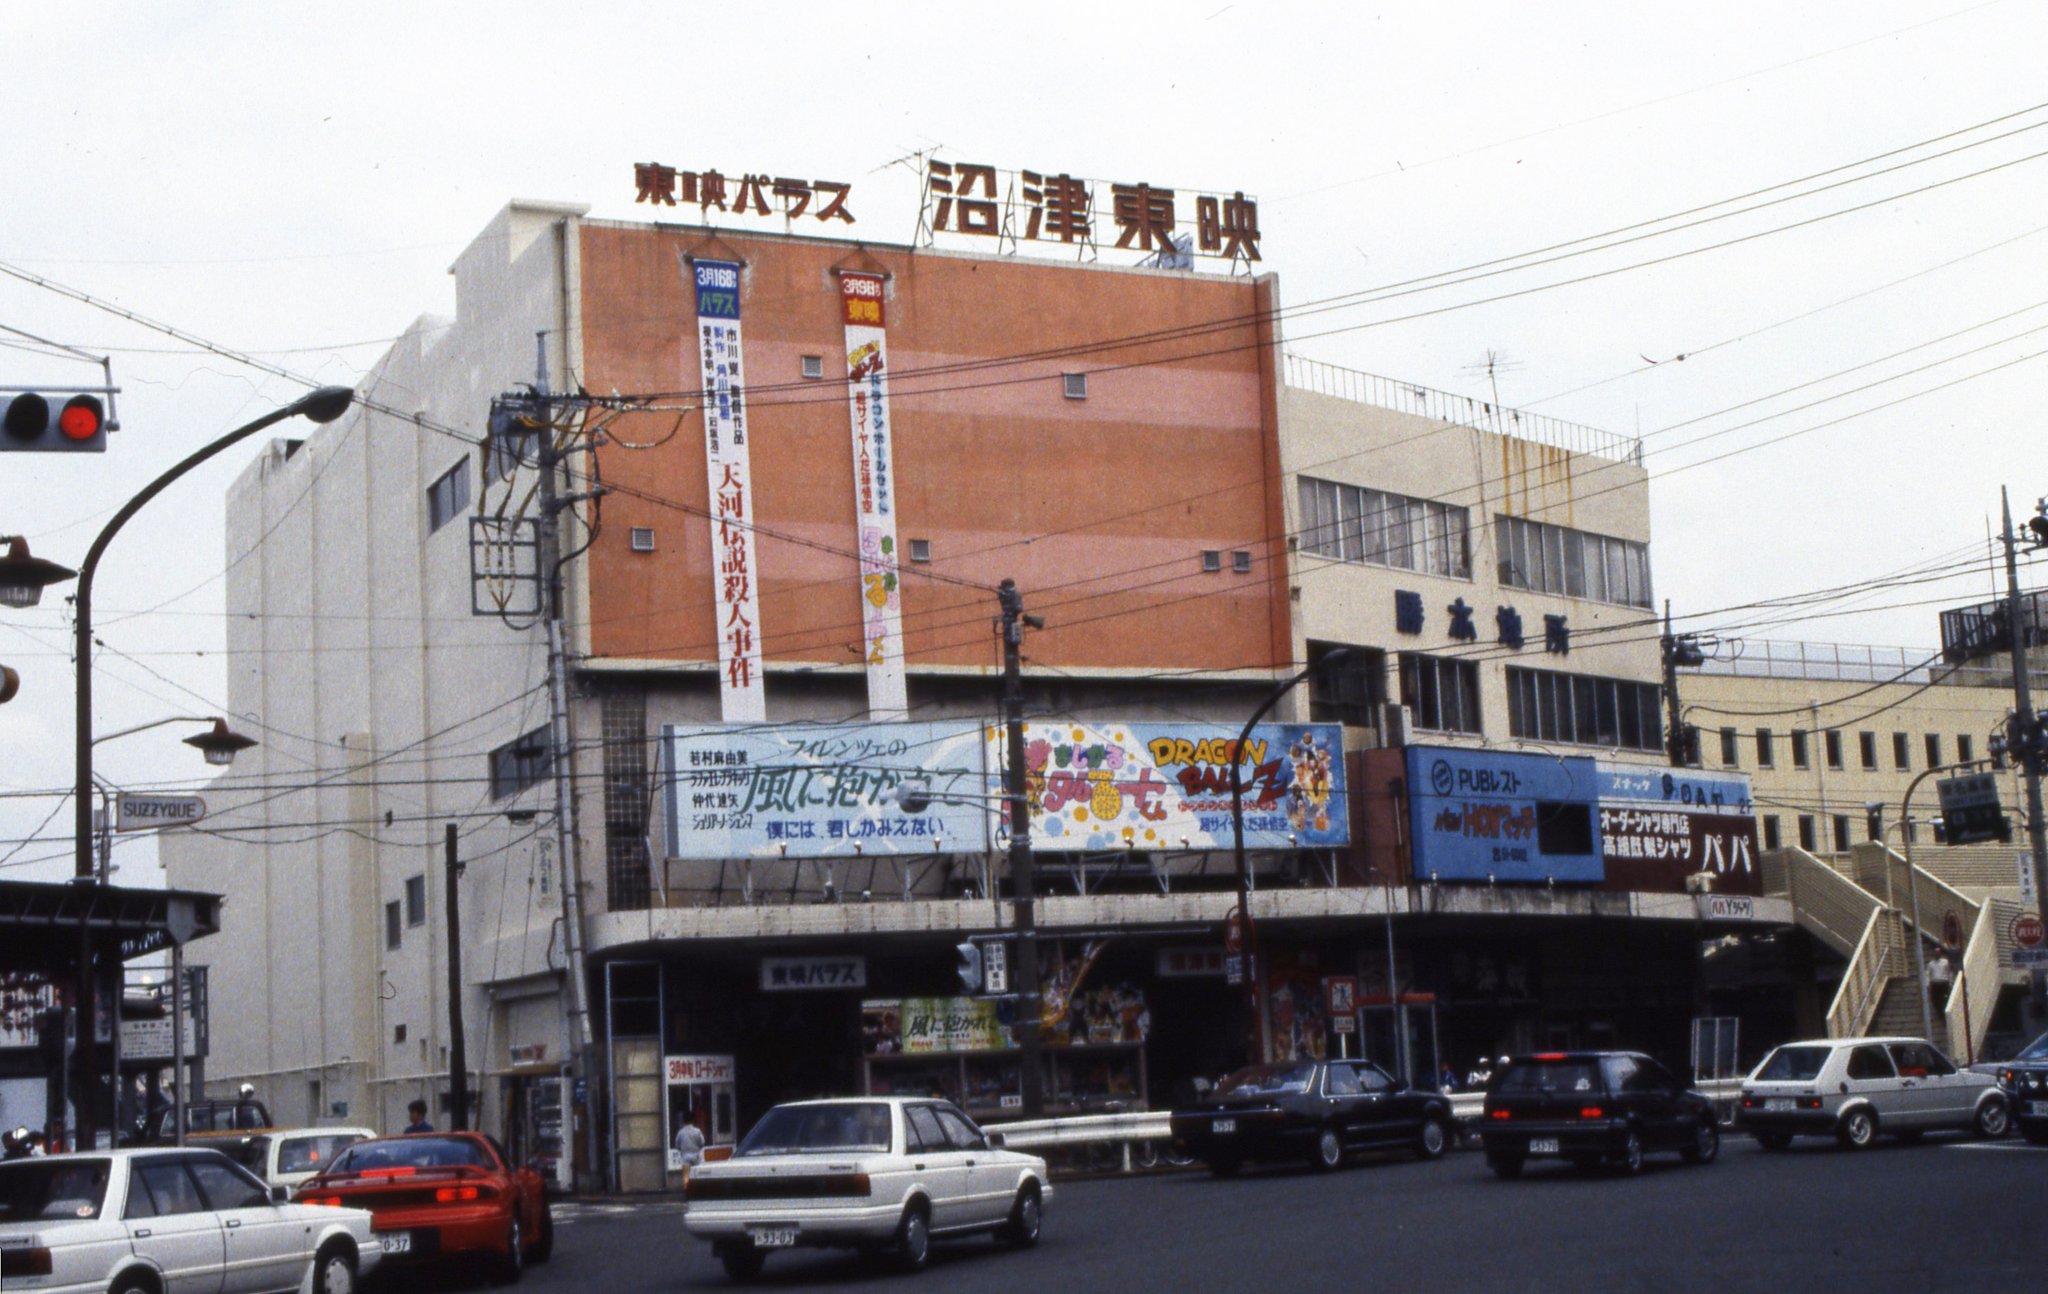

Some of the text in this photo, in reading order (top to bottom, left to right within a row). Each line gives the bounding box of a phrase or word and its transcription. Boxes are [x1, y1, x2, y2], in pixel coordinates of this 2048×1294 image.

[634, 162, 856, 224] 東映パラス
[929, 159, 1262, 261] 沼津東映
[718, 462, 752, 688] 天河伝説殺人事件
[1148, 737, 1268, 768] DRAGON
[1253, 757, 1287, 801] Z
[1612, 776, 1650, 792] スナック
[1738, 797, 1753, 814] 2F
[123, 802, 197, 819] SUZZYQUE
[1600, 809, 1690, 835] オーダーシャツ専門店
[1702, 833, 1752, 875] パパ
[772, 962, 858, 985] 東映パラス
